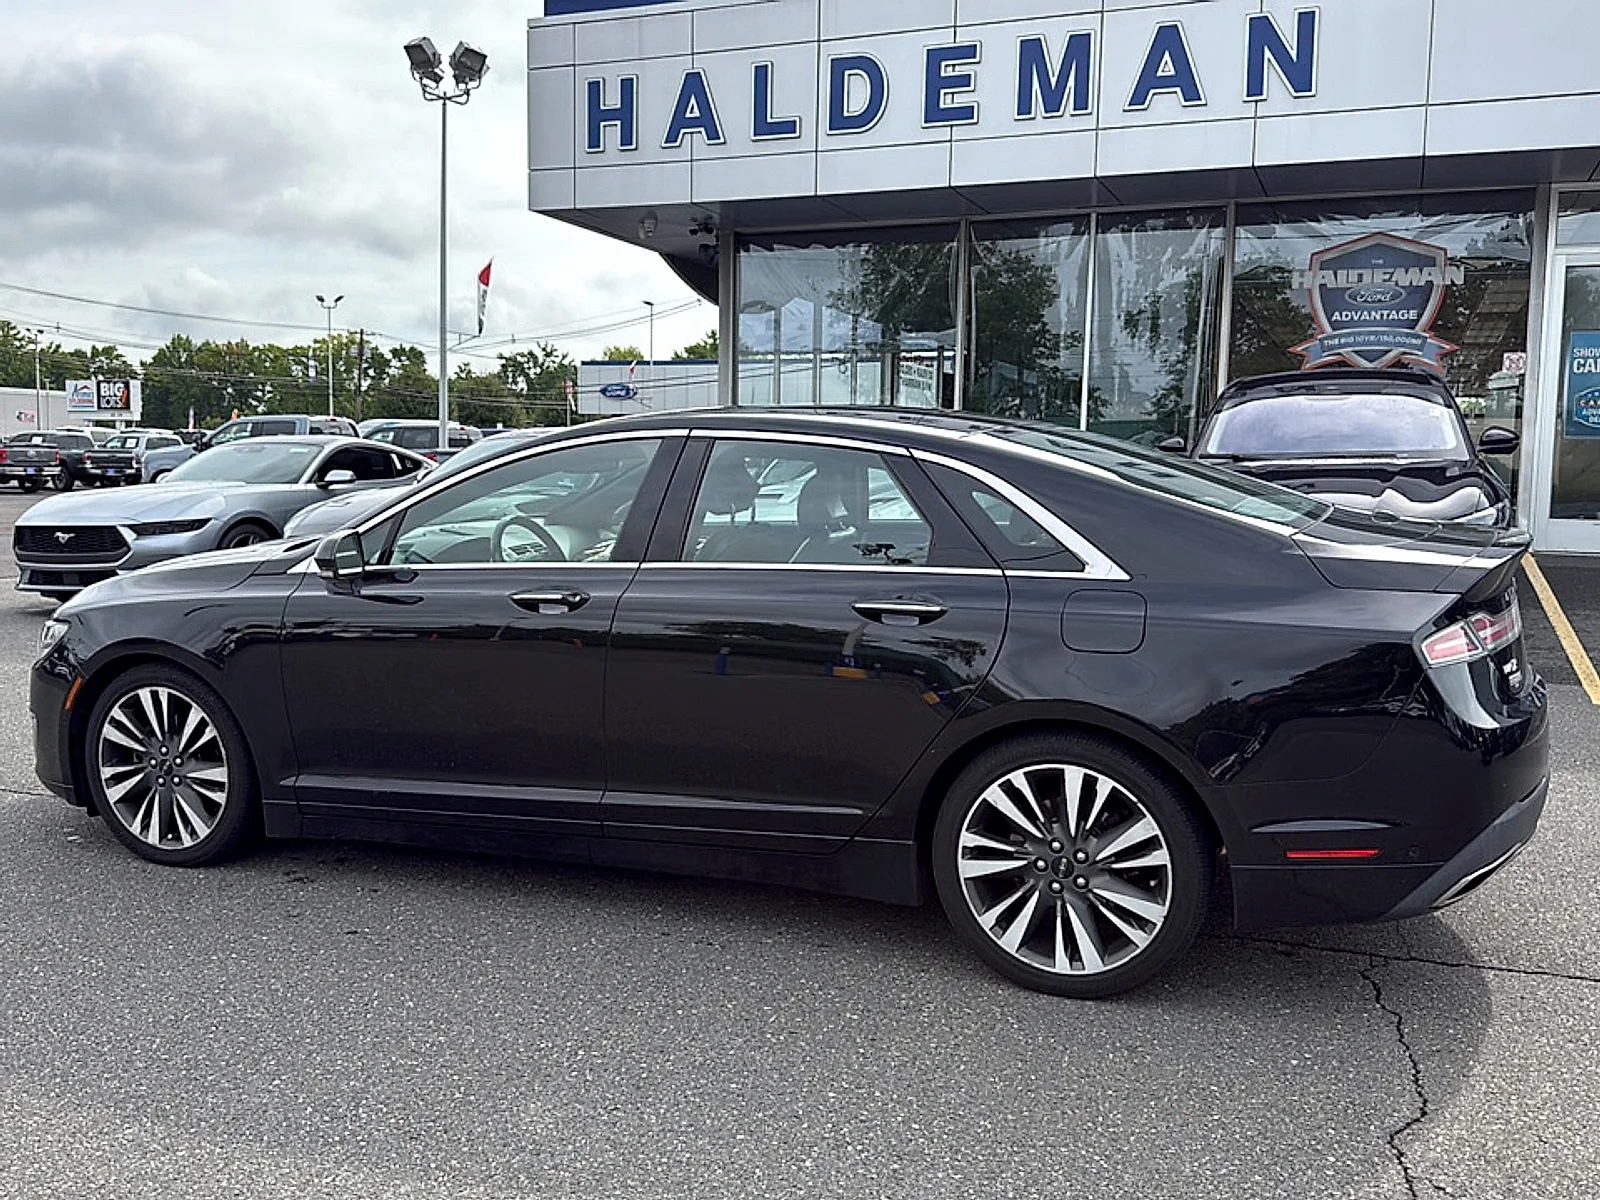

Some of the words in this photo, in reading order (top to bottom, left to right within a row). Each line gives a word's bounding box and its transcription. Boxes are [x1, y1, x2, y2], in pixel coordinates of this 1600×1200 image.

[586, 7, 1320, 153] HALDEMAN
[1356, 292, 1393, 302] Ford
[1332, 310, 1418, 321] ADVANTAGE
[101, 383, 124, 396] BIG
[101, 397, 122, 408] LOTS
